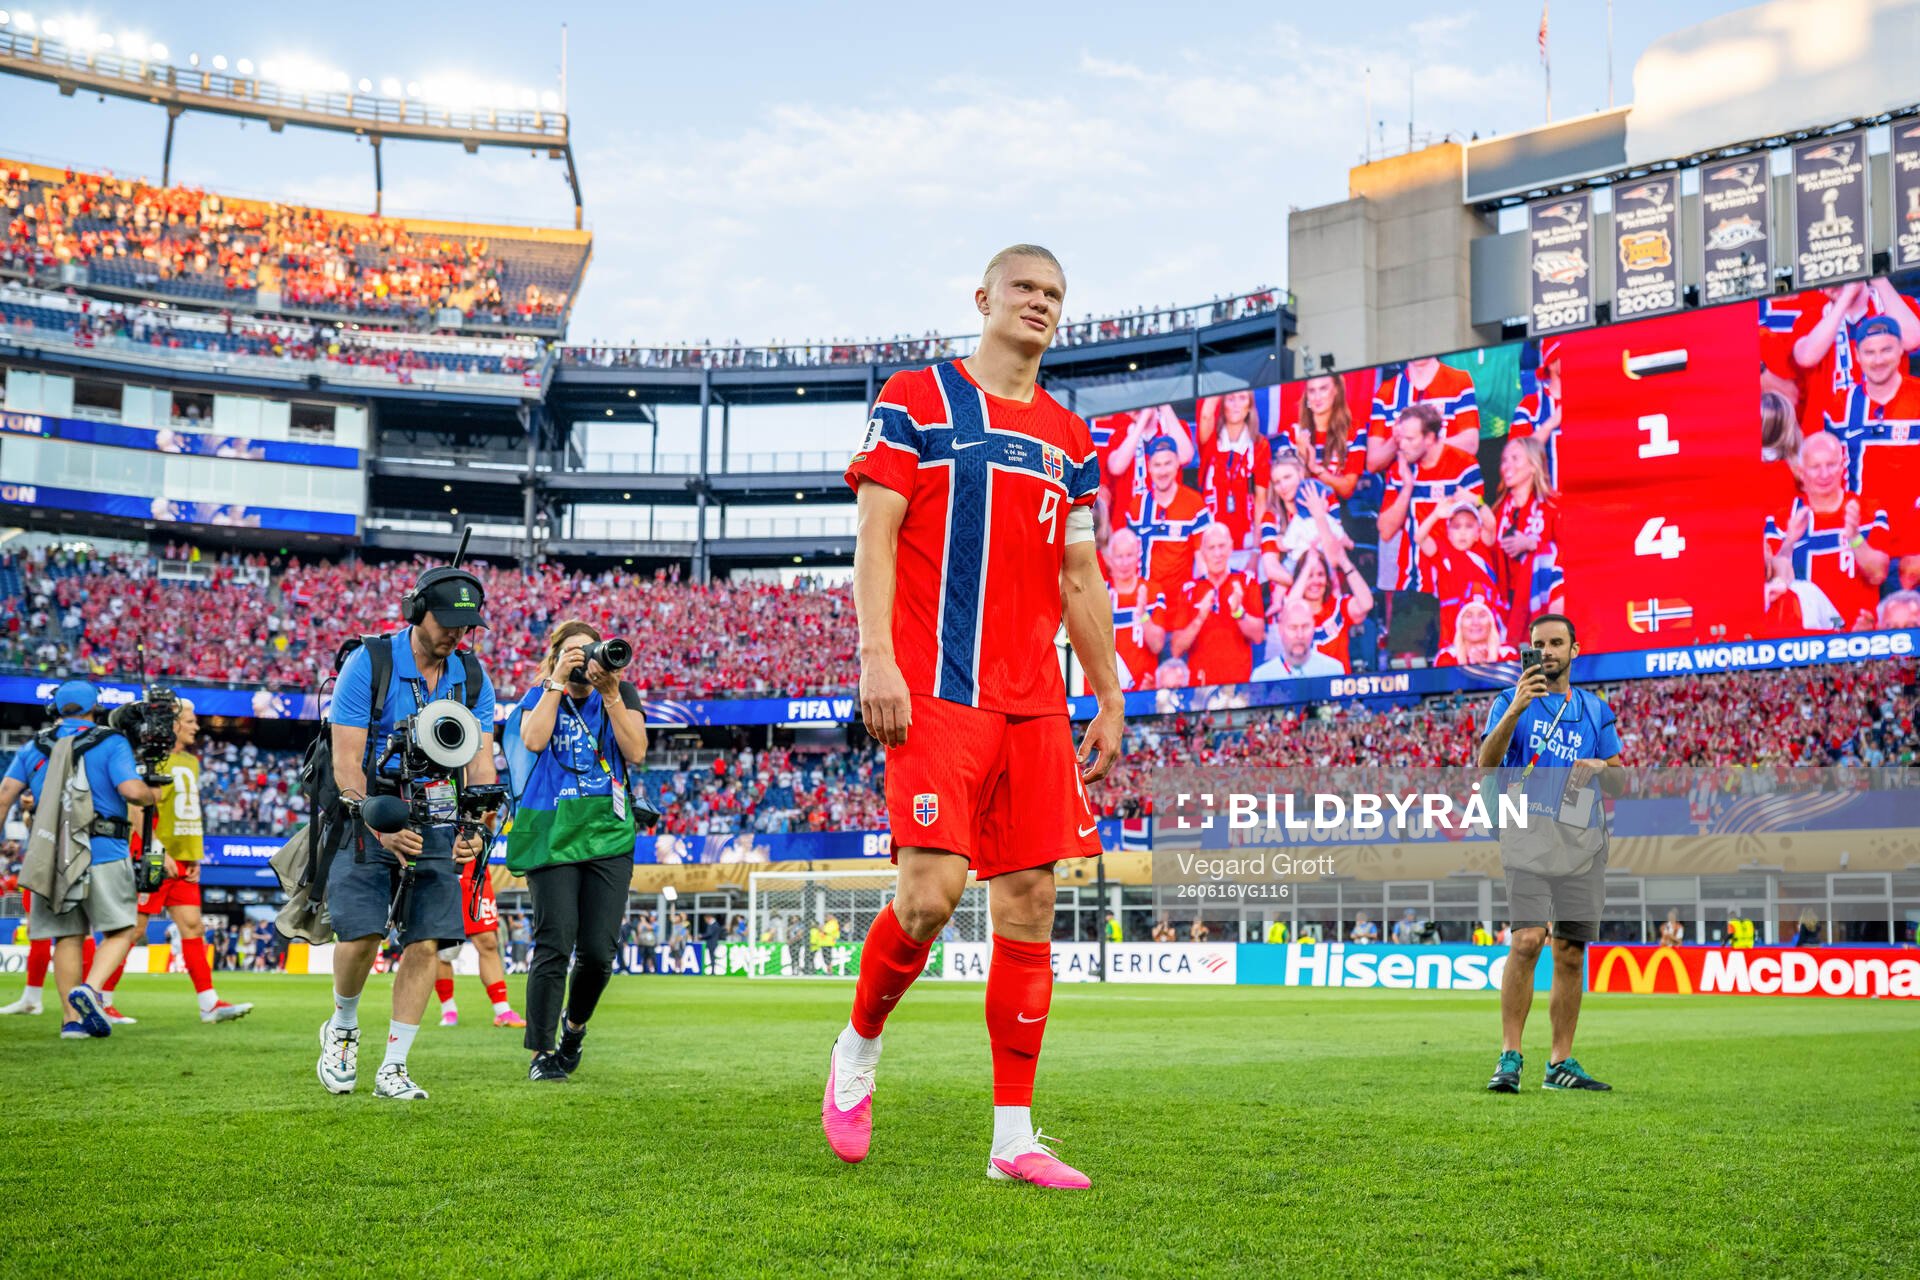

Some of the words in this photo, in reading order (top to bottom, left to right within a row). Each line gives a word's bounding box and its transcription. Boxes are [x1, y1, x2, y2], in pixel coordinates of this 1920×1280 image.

[1803, 255, 1861, 282] 2014
[1618, 291, 1675, 315] 2003
[1537, 306, 1587, 330] 2001
[1638, 413, 1680, 459] 1
[1038, 488, 1061, 544] 9
[1634, 516, 1686, 560] 4
[1646, 652, 1693, 673] FIFA
[1694, 644, 1776, 669] WORLD
[1778, 640, 1826, 663] CUP
[1827, 633, 1913, 659] 2026
[1330, 674, 1409, 697] BOSTON
[788, 700, 831, 720] FIFA
[1529, 734, 1578, 761] DGITAL
